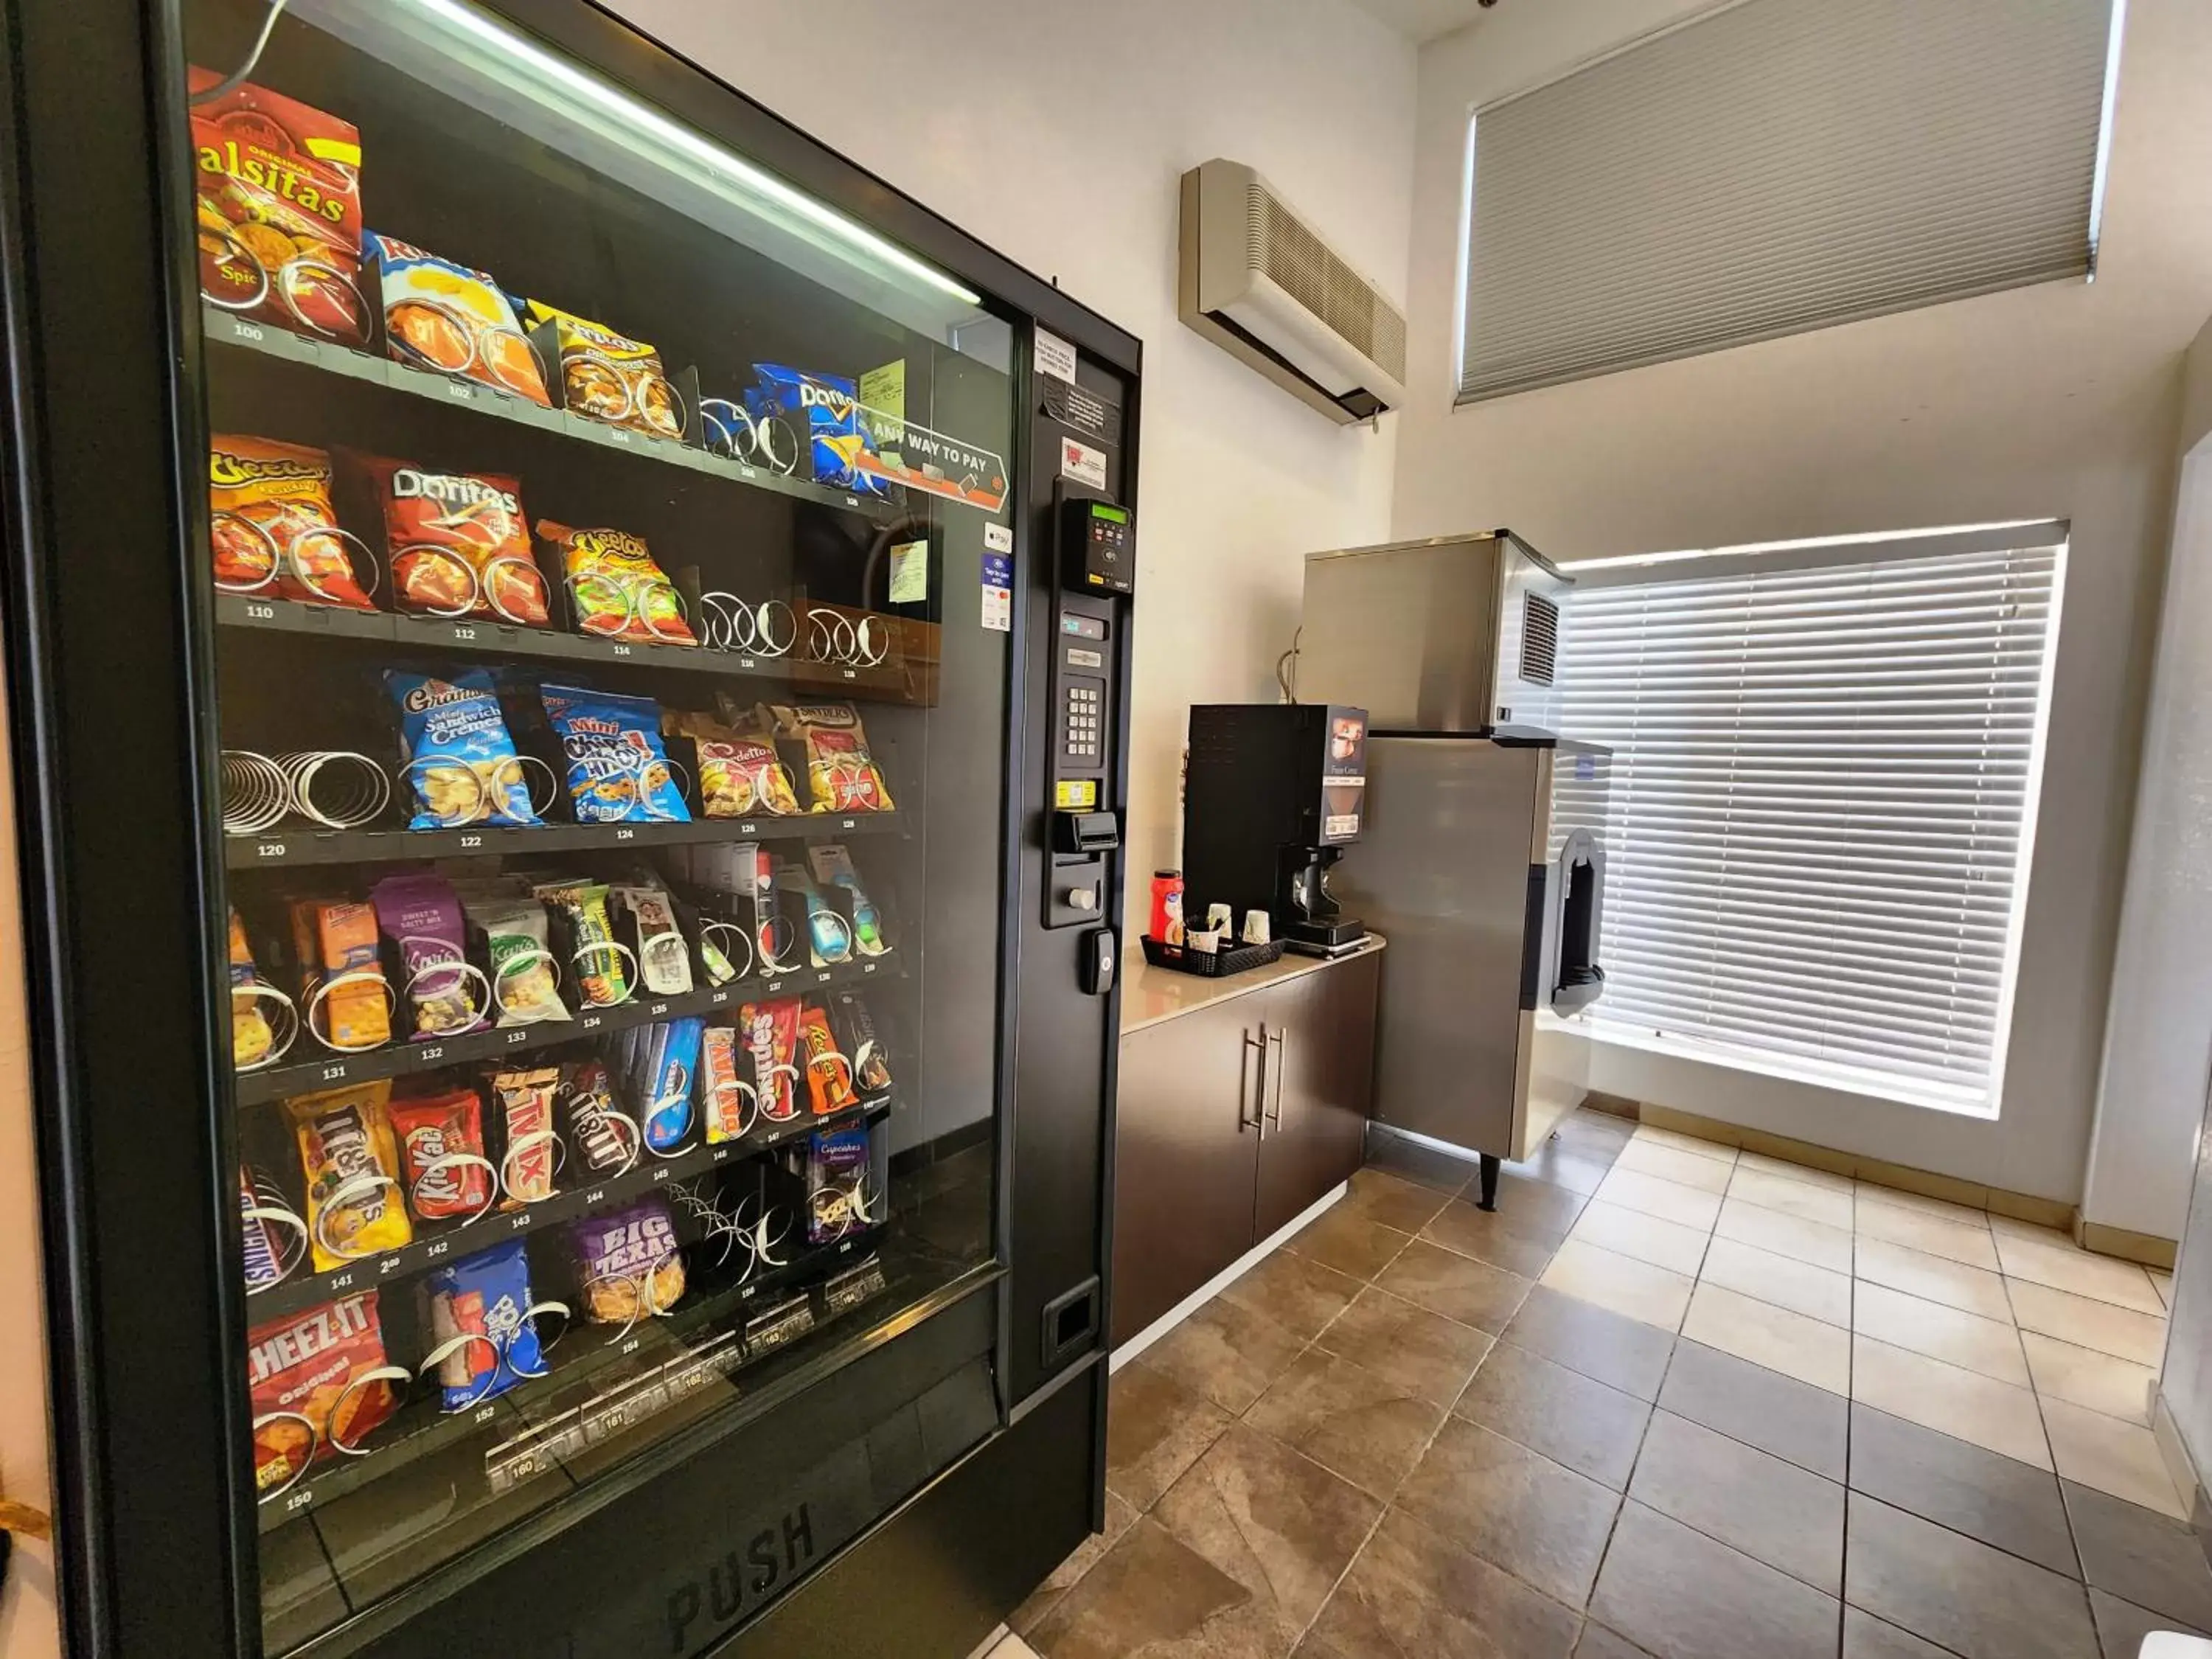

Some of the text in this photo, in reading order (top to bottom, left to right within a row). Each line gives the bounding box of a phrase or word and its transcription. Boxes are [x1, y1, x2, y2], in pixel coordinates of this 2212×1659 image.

[199, 141, 347, 223] alsitas
[234, 324, 263, 341] 100
[448, 385, 470, 400] 102
[800, 383, 854, 407] Dorito
[873, 422, 987, 473] ANY WAY TO PAY
[393, 467, 519, 515] Doritos
[573, 530, 647, 559] Cheetos
[247, 605, 274, 619] 110
[455, 628, 476, 640] 112
[613, 646, 630, 655] 114
[425, 706, 501, 732] Sandwich
[568, 717, 619, 734] Mini
[431, 717, 503, 745] Cremes
[460, 836, 481, 848] 122
[616, 830, 633, 840] 124
[257, 844, 286, 857] 120
[768, 982, 782, 992] 137
[650, 1004, 667, 1015] 135
[583, 1017, 601, 1028] 134
[507, 1032, 526, 1043] 133
[420, 1047, 443, 1060] 132
[810, 1025, 837, 1081] Reee's
[748, 1014, 776, 1112] Skittles
[322, 1066, 345, 1079] 131
[821, 1144, 861, 1155] Cupcakes
[653, 1169, 669, 1180] 145
[586, 1192, 604, 1203] 144
[512, 1216, 531, 1228] 143
[602, 1216, 669, 1253] BIG
[428, 1242, 448, 1256] 142
[596, 1234, 676, 1274] TEXAS
[330, 1275, 352, 1290] 141
[249, 1296, 369, 1386] HEEZ-IT
[622, 1340, 639, 1355] 154
[685, 1373, 703, 1388] 162
[475, 1406, 495, 1423] 152
[605, 1413, 624, 1429] 161
[513, 1460, 533, 1478] 160
[287, 1490, 312, 1511] 150
[667, 1502, 813, 1654] PUSH
